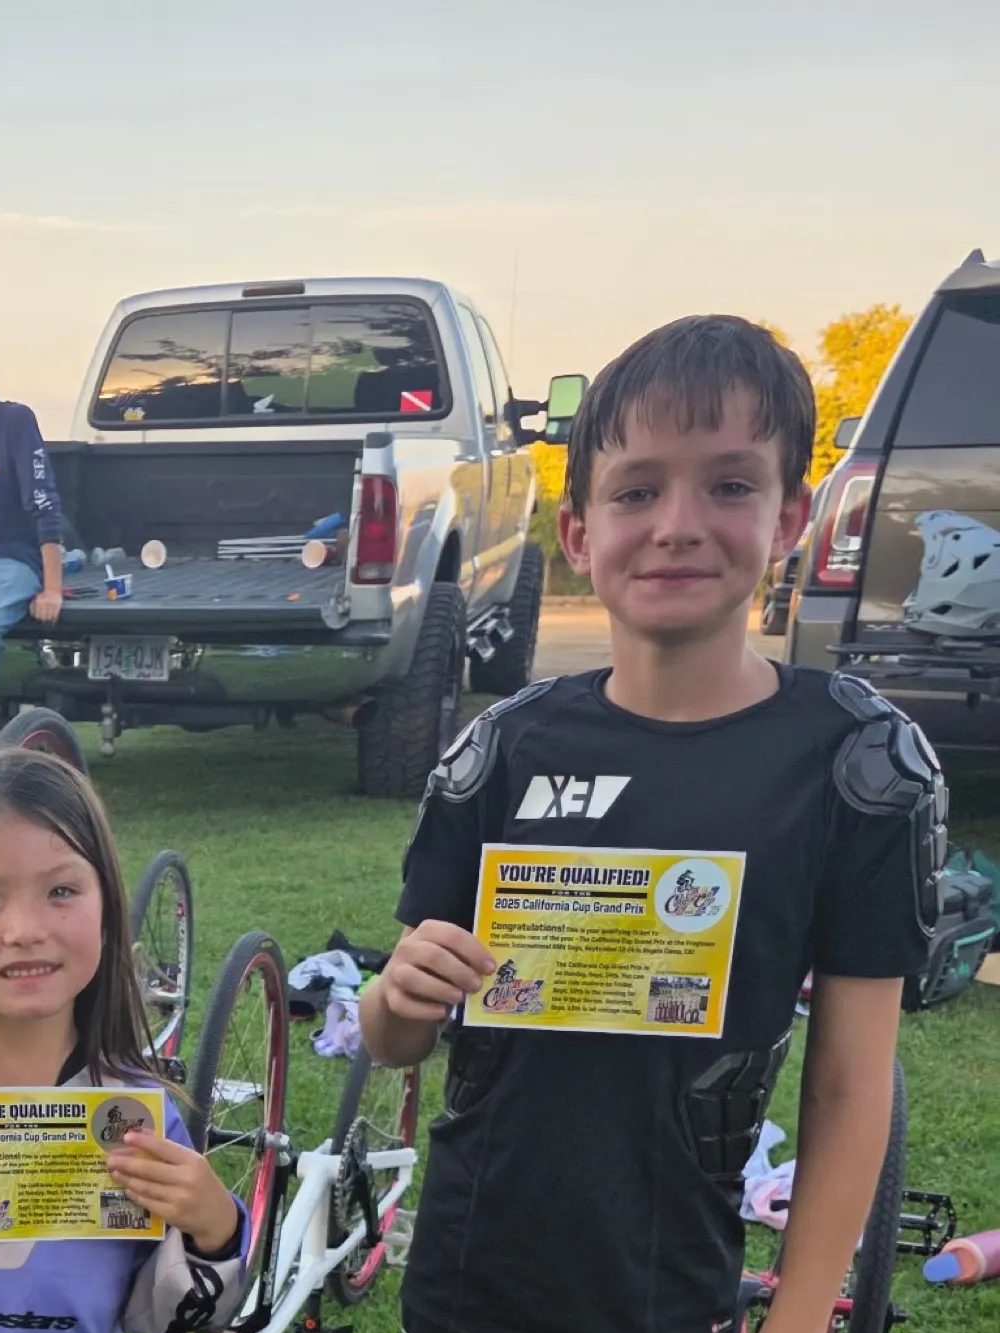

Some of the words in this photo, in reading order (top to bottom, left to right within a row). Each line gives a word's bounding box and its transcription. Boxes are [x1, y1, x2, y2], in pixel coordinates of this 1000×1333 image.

[498, 864, 556, 883] YOU'RE
[558, 866, 650, 886] QUALIFIED!
[494, 898, 520, 909] 2025
[522, 898, 570, 911] California
[571, 900, 591, 913] Cup
[592, 901, 622, 913] Grand
[624, 902, 644, 914] Prix
[491, 921, 565, 933] Congratulations!
[10, 1104, 86, 1121] QUALIFIED!
[24, 1132, 40, 1143] Cup
[42, 1132, 66, 1141] Grand
[68, 1132, 84, 1141] Prix
